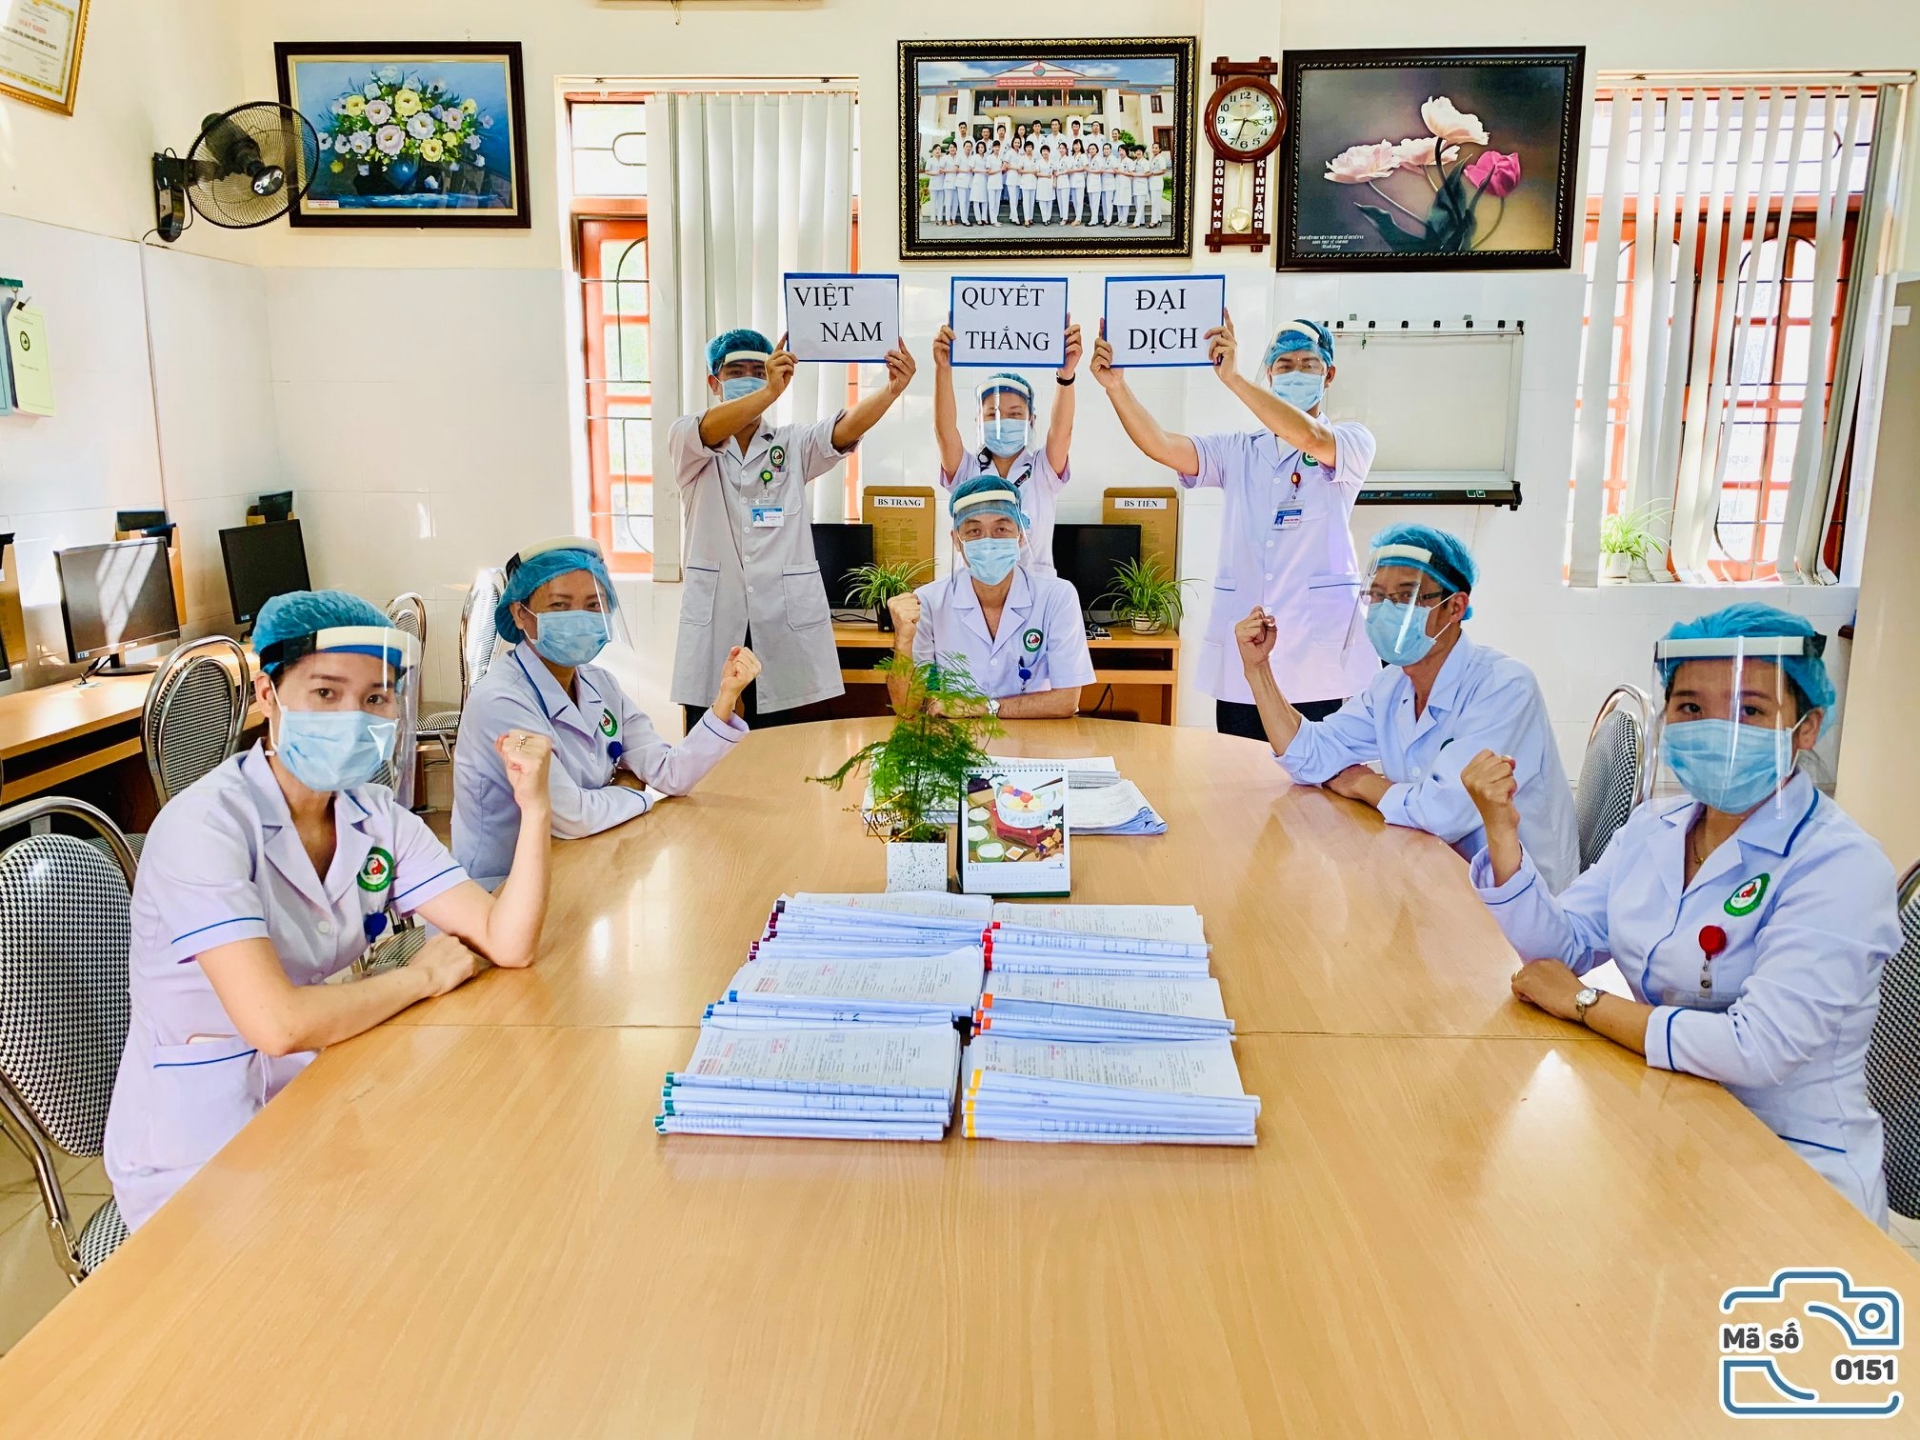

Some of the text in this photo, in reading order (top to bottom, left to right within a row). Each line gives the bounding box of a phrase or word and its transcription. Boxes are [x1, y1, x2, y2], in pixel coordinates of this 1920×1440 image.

[1240, 91, 1251, 99] 12
[1220, 103, 1230, 112] 10
[1262, 103, 1270, 111] 2
[1217, 116, 1225, 124] 9
[1264, 116, 1273, 124] 3
[1220, 128, 1228, 136] 8
[1260, 128, 1268, 136] 4
[1240, 140, 1248, 149] 6
[1252, 137, 1261, 145] 5
[793, 282, 854, 311] VIỆT
[1135, 288, 1187, 315] ĐẠI
[820, 321, 884, 342] NAM
[965, 325, 1050, 351] THẮNG
[1128, 327, 1198, 354] DỊCH
[877, 498, 922, 507] BS TRANG
